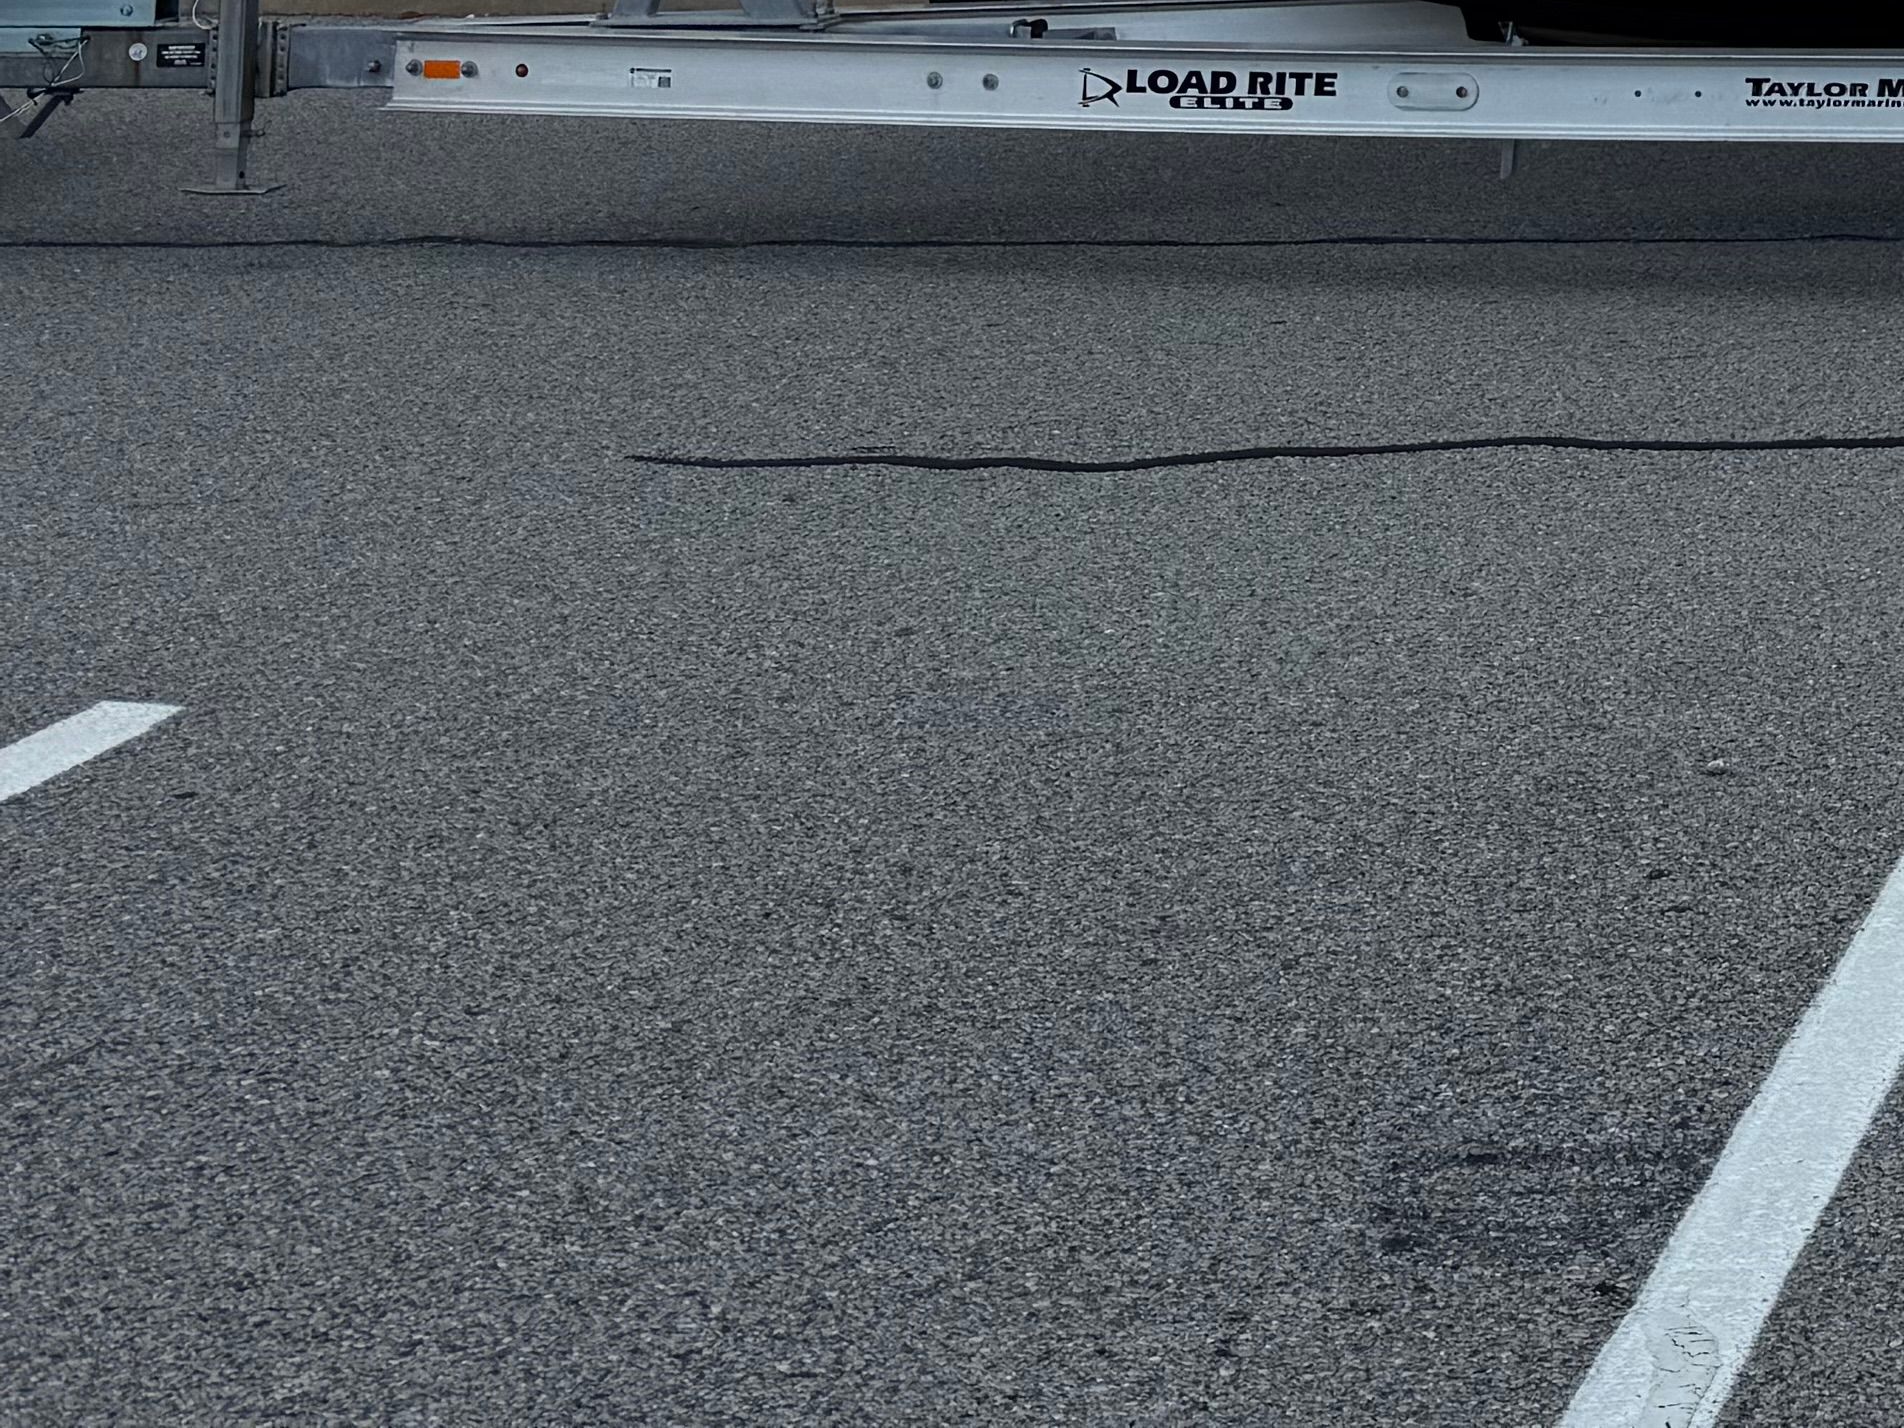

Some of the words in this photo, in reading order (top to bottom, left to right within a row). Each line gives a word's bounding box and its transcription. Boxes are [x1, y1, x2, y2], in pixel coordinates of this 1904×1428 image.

[1125, 68, 1237, 94] LOAD
[1247, 71, 1338, 97] RITE
[1744, 77, 1869, 97] TAYLOR
[1178, 96, 1284, 110] ELITE
